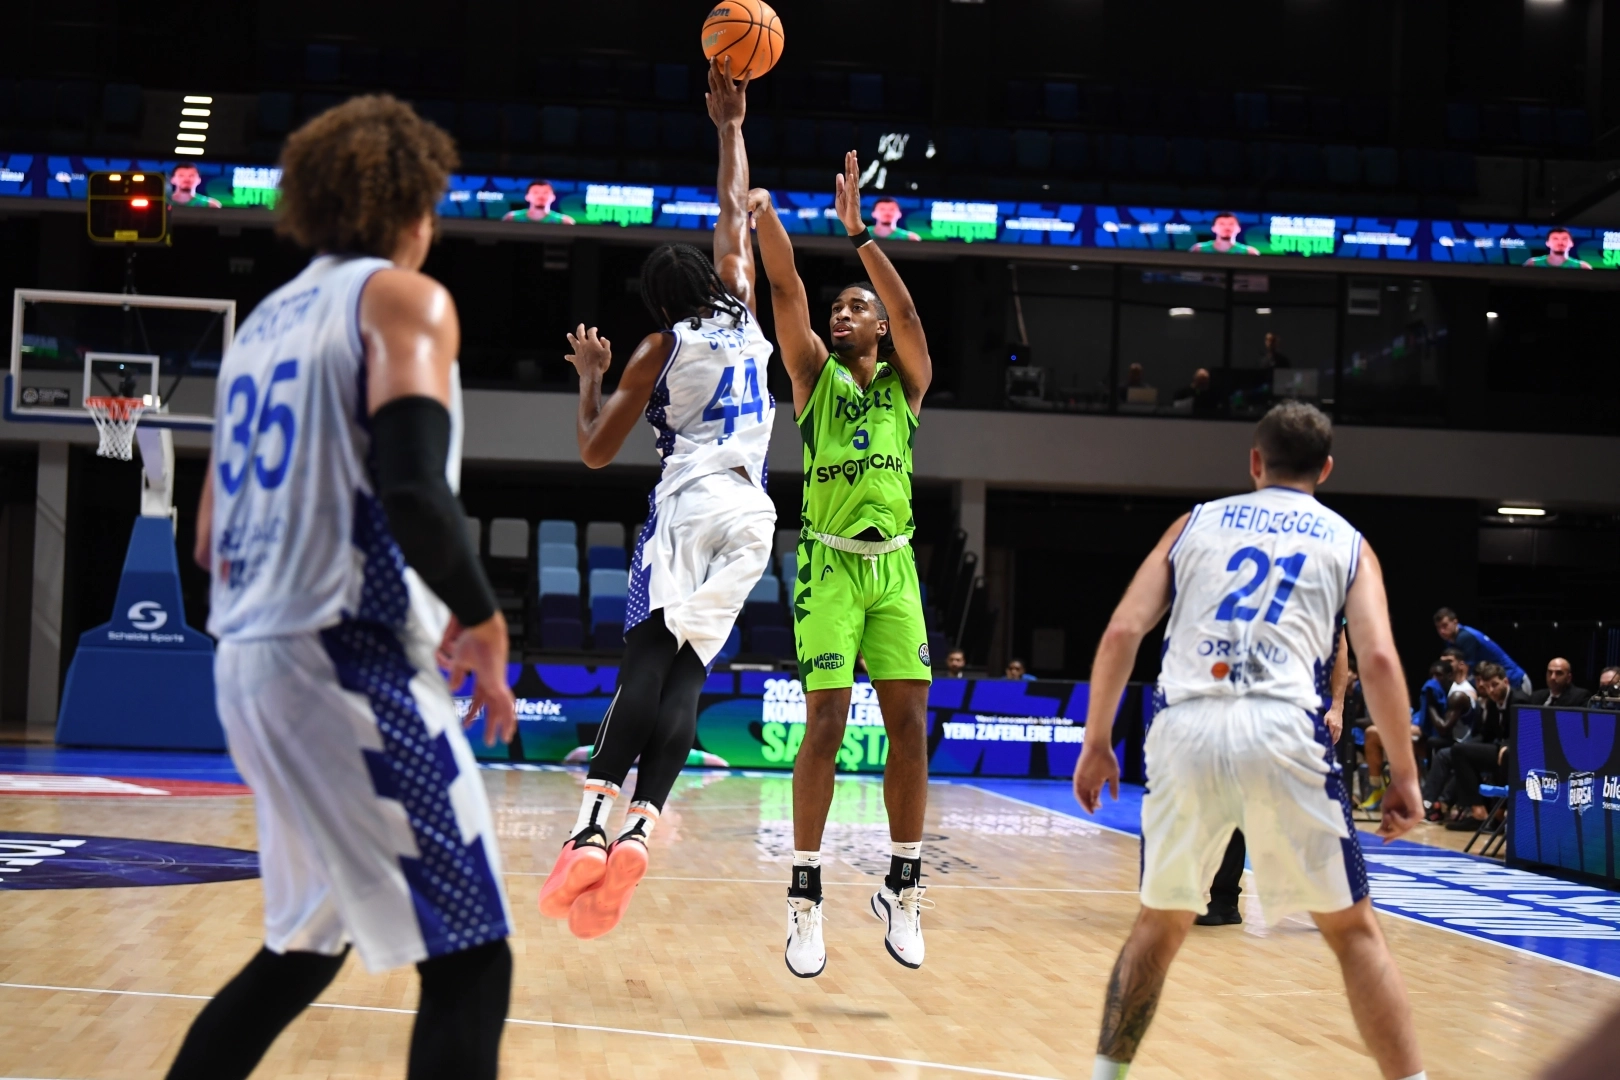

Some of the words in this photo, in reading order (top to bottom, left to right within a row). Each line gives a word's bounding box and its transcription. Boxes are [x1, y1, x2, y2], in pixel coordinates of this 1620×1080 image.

[219, 359, 298, 496] 35
[702, 358, 763, 434] 44
[1220, 505, 1340, 543] HEIDEGGER
[1215, 546, 1307, 625] 21
